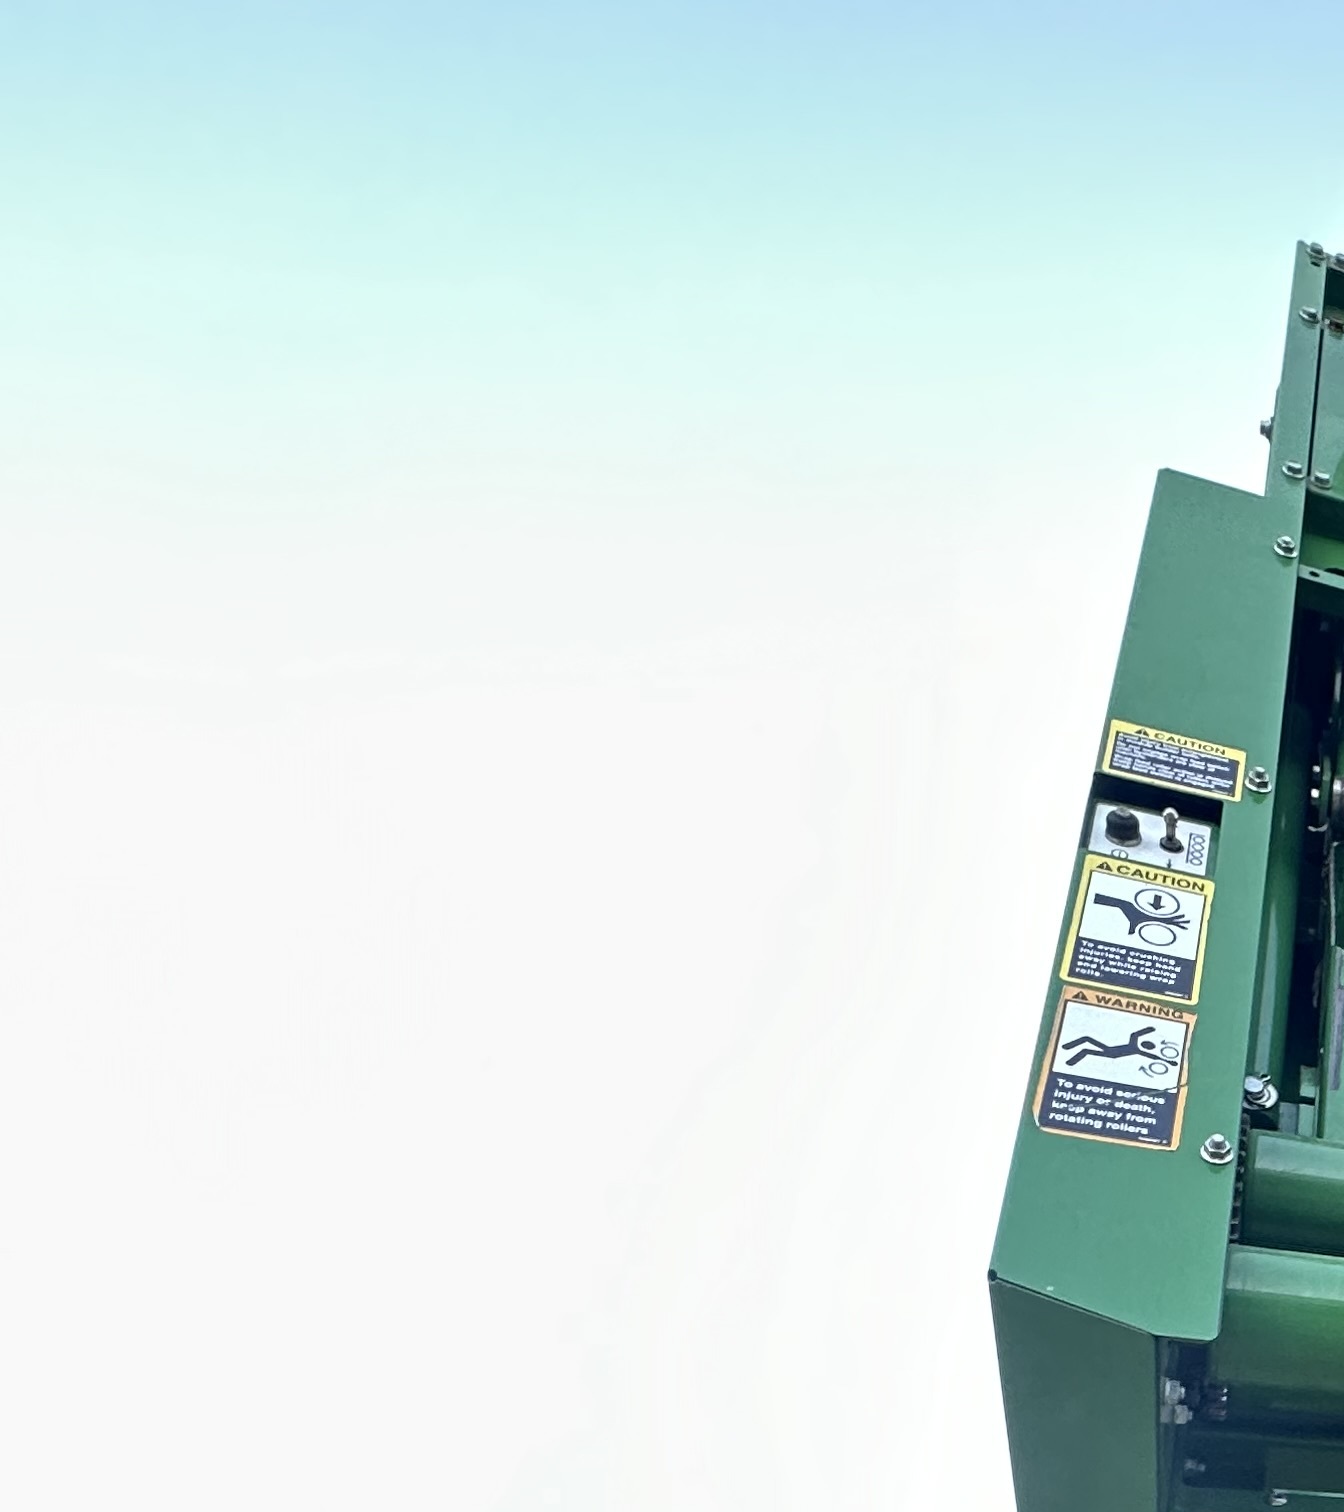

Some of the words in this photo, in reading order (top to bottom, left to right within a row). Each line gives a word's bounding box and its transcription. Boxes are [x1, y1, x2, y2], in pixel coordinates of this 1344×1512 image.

[1154, 732, 1226, 756] CAUTION
[1117, 865, 1205, 892] CAUTION
[1081, 940, 1095, 948] To
[1097, 944, 1126, 955] avoid
[1129, 950, 1175, 966] crushing
[1127, 956, 1152, 967] keep
[1077, 960, 1097, 969] and
[1101, 964, 1147, 980] lowering
[1149, 974, 1175, 985] wrap
[1078, 954, 1105, 965] away
[1109, 959, 1136, 970] while
[1140, 966, 1177, 979] raising
[1095, 995, 1184, 1019] WARNING
[1053, 1088, 1094, 1104] injury
[1114, 1100, 1156, 1115] death,
[1057, 1078, 1073, 1088] To
[1076, 1083, 1113, 1096] avoid
[1116, 1089, 1166, 1105] serious
[1048, 1112, 1103, 1129] rotating
[1106, 1120, 1149, 1135] rollers
[1088, 1107, 1123, 1121] away
[1125, 1111, 1157, 1125] from
